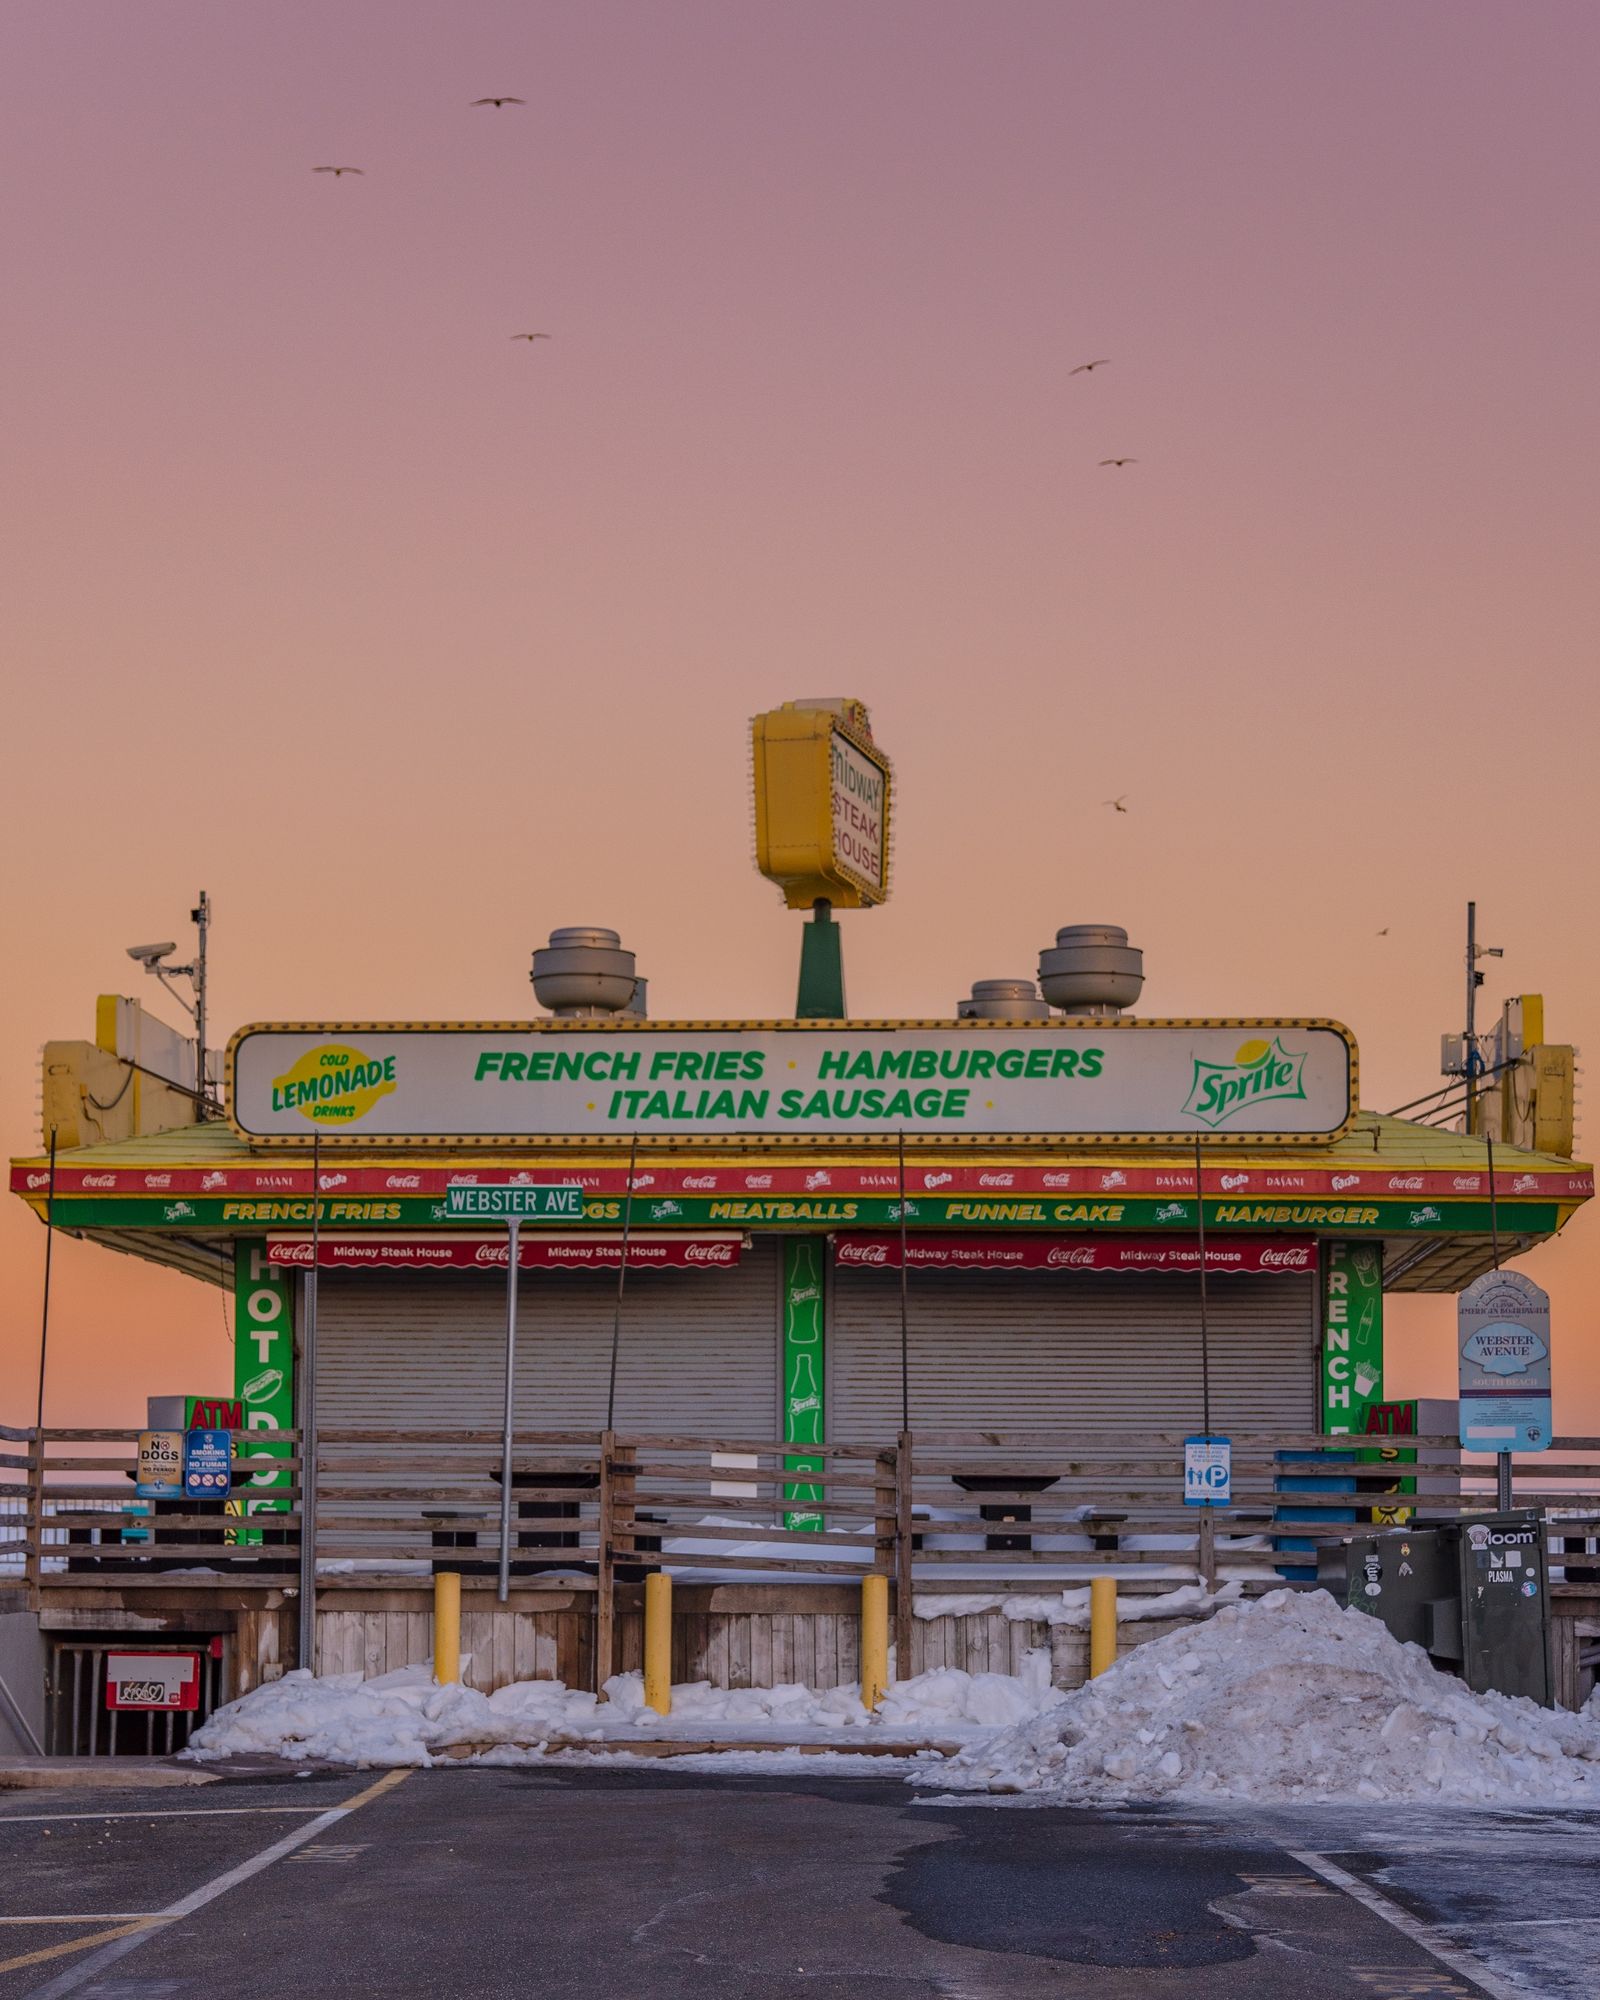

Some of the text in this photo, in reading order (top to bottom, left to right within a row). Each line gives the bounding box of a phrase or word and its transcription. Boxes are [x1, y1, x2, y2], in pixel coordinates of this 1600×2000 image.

[832, 791, 879, 845] STEAK
[834, 828, 879, 877] HOUSE
[319, 1053, 349, 1067] COLD
[474, 1050, 766, 1081] FRENCH FRIES
[817, 1049, 1105, 1080] HAMBURGERS
[272, 1055, 397, 1112] LEMONADE
[1196, 1055, 1293, 1115] Sprite
[312, 1105, 356, 1118] DRINKS
[607, 1089, 970, 1119] ITALIAN SAUSAGE
[256, 1176, 293, 1187] DASANI
[319, 1173, 348, 1190] Fanta
[860, 1176, 897, 1187] DASANI
[924, 1173, 953, 1189] Fanta
[1156, 1176, 1193, 1187] DASANI
[1220, 1173, 1249, 1190] Fanta
[1266, 1177, 1304, 1188] DASANI
[1331, 1174, 1360, 1191] Fanta
[451, 1191, 579, 1211] WEBSTER AVE
[223, 1203, 401, 1220] FRENCH FRIES
[709, 1203, 859, 1219] MEATBALLS
[945, 1204, 1126, 1221] FUNNEL CAKE
[1215, 1206, 1379, 1224] HAMBURGER
[333, 1247, 379, 1259] Midway
[381, 1247, 414, 1257] Steak
[416, 1247, 453, 1258] House
[548, 1248, 593, 1259] Midway
[631, 1247, 667, 1257] House
[904, 1249, 948, 1260] Midway
[951, 1250, 985, 1260] Steak
[987, 1250, 1024, 1260] House
[1120, 1251, 1165, 1262] Midway
[1168, 1251, 1201, 1261] Steak
[1205, 1251, 1241, 1261] House
[1468, 1271, 1537, 1297] WELCOME TO
[247, 1248, 282, 1363] HOT
[1460, 1308, 1498, 1316] AMERICAN
[1327, 1242, 1350, 1408] FRENCH
[1475, 1335, 1534, 1346] WEBSTER
[1480, 1346, 1530, 1356] AVENUE
[1472, 1378, 1504, 1387] SOUTH
[190, 1400, 242, 1429] ATM
[1365, 1404, 1412, 1435] ATM
[141, 1450, 179, 1461] DOGS
[1210, 1467, 1226, 1487] P
[1488, 1571, 1514, 1583] PLASMA
